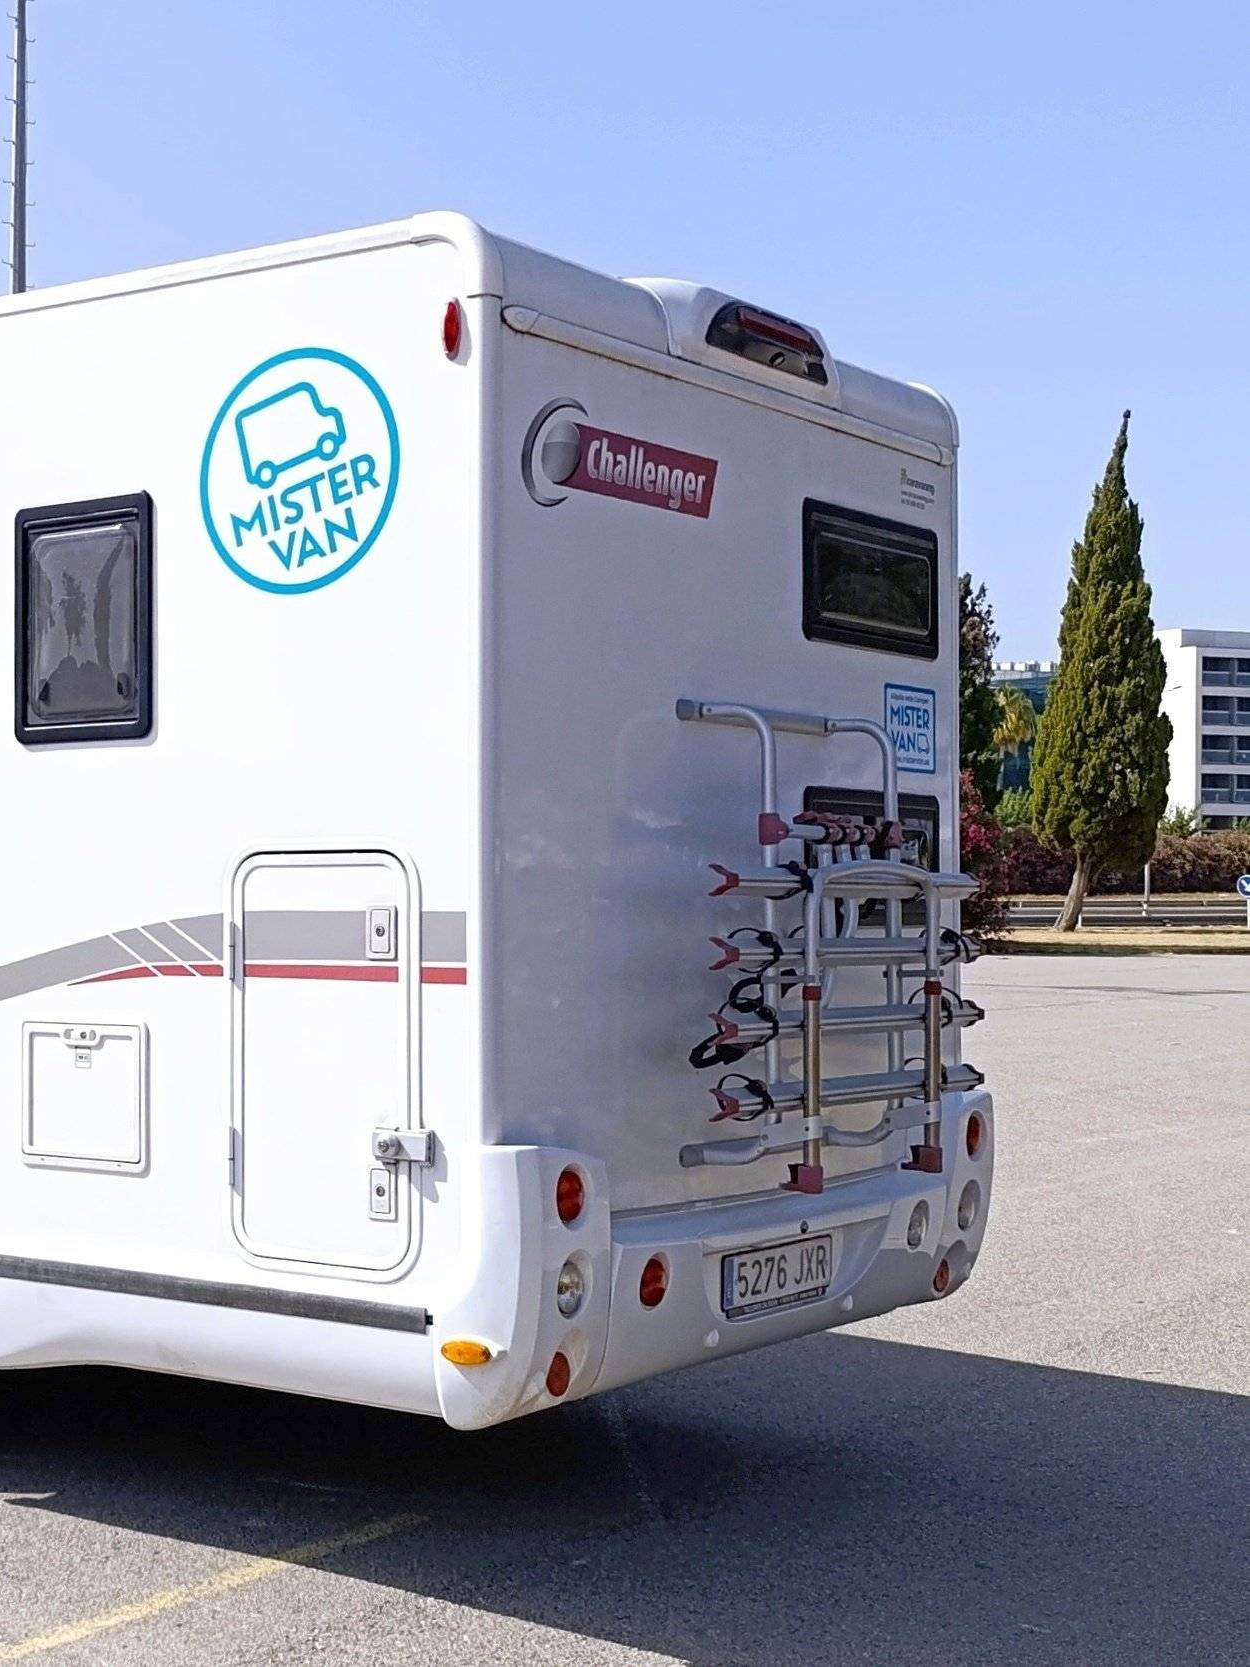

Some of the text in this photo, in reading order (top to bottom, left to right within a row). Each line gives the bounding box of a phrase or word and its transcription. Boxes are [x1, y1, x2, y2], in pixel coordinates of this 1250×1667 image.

[230, 453, 381, 548] MISTER
[586, 437, 706, 509] Challenger
[267, 506, 359, 572] VAN
[890, 704, 930, 731] MISTER
[891, 729, 916, 753] VAN
[737, 1244, 827, 1298] 5276 JXR
